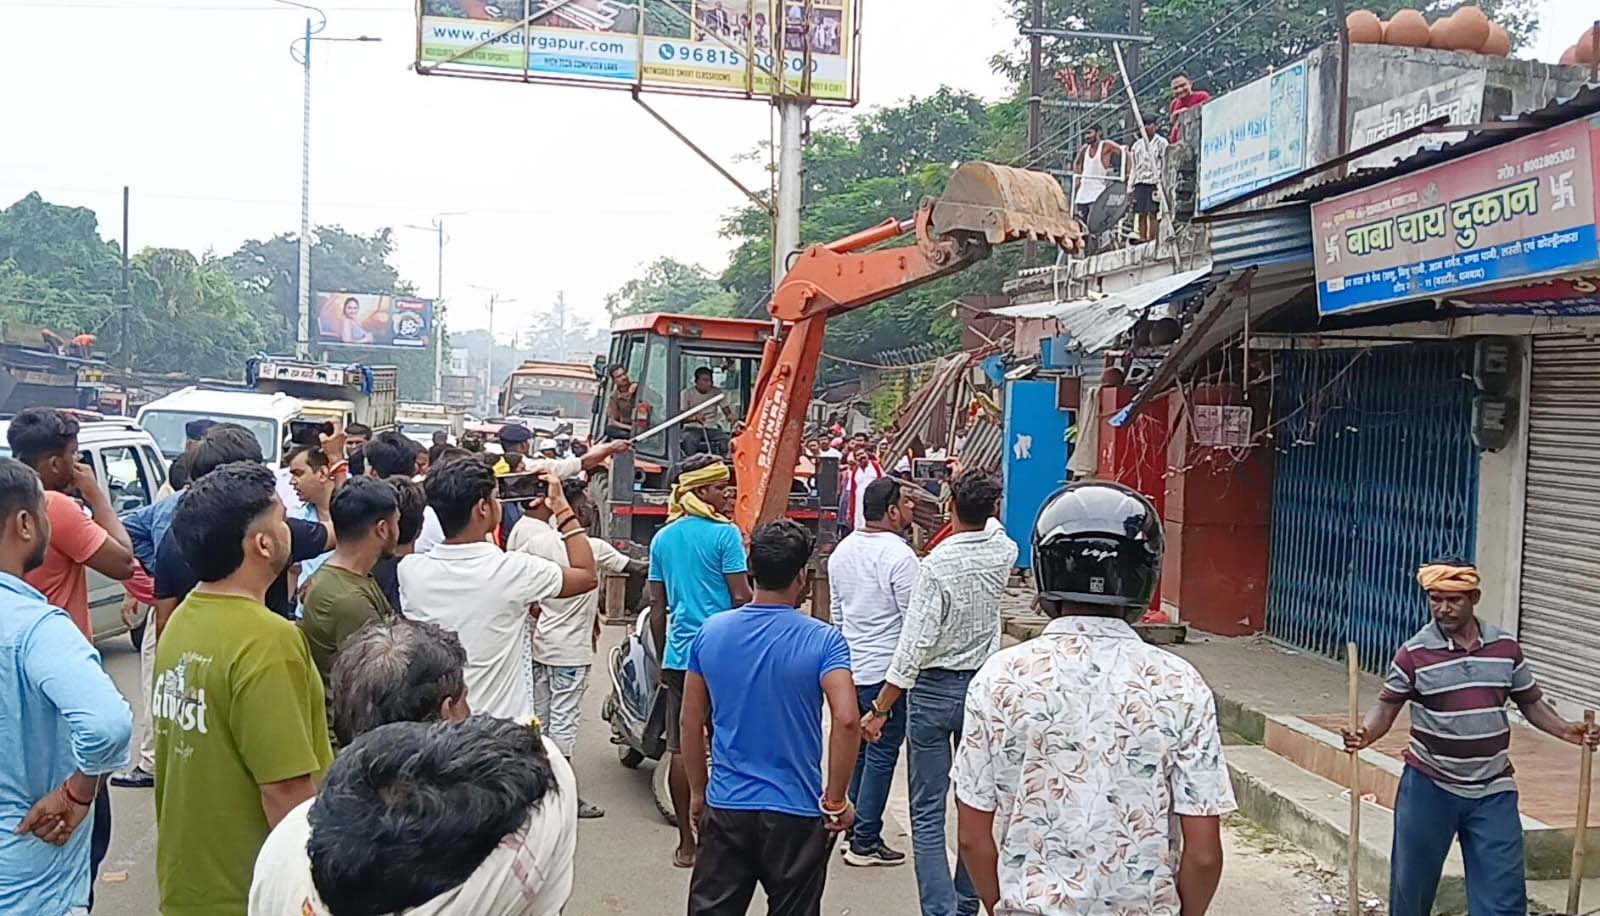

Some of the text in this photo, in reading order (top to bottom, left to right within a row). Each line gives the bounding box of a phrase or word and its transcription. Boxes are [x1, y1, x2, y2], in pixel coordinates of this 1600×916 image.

[676, 69, 694, 78] SMART
[679, 46, 739, 65] 96815
[1345, 217, 1394, 255] बाबा
[1397, 203, 1447, 244] चाय
[1451, 178, 1540, 248] दुकान
[757, 382, 785, 468] SHINRAI
